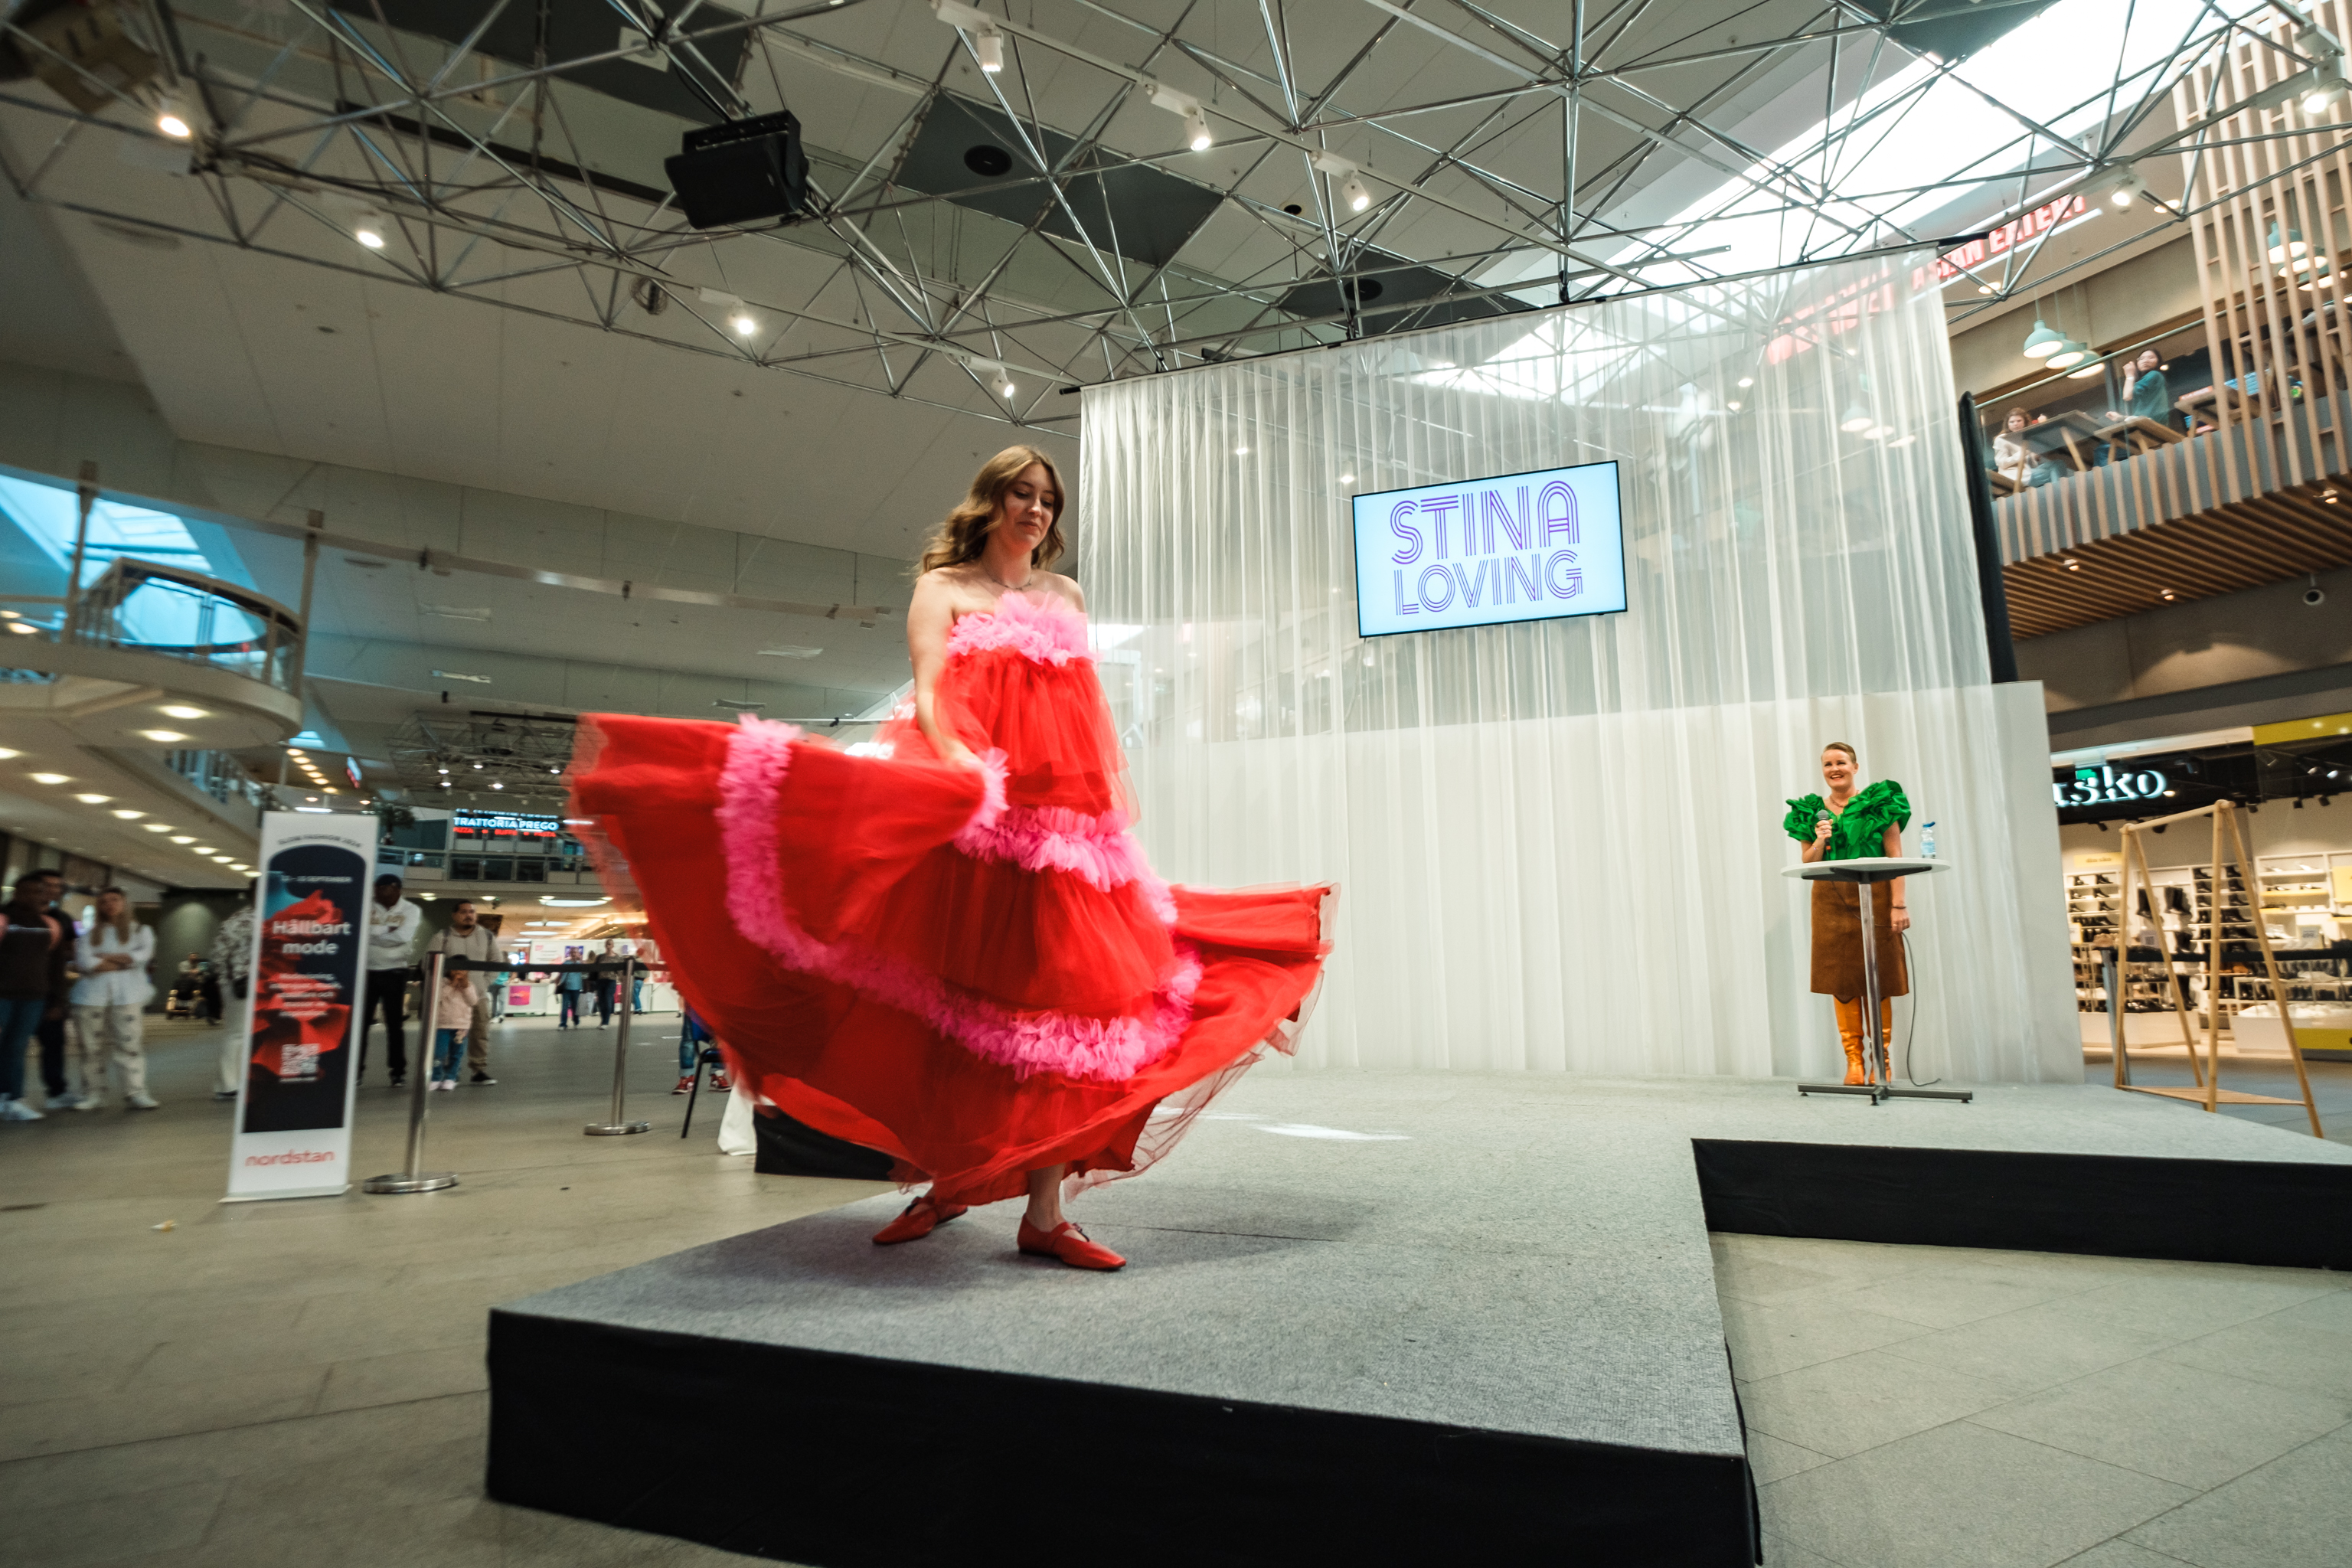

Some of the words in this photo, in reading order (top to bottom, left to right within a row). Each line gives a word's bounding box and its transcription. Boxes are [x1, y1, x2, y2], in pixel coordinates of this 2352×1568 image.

[1988, 194, 2086, 254] EATERY
[1390, 480, 1581, 565] STINA
[1393, 550, 1583, 616] LOVING
[453, 816, 518, 829] TRATTORIA
[519, 820, 560, 831] PREGO
[272, 919, 352, 936] Hållbart
[282, 939, 339, 955] mode
[244, 1148, 336, 1167] nordstan
